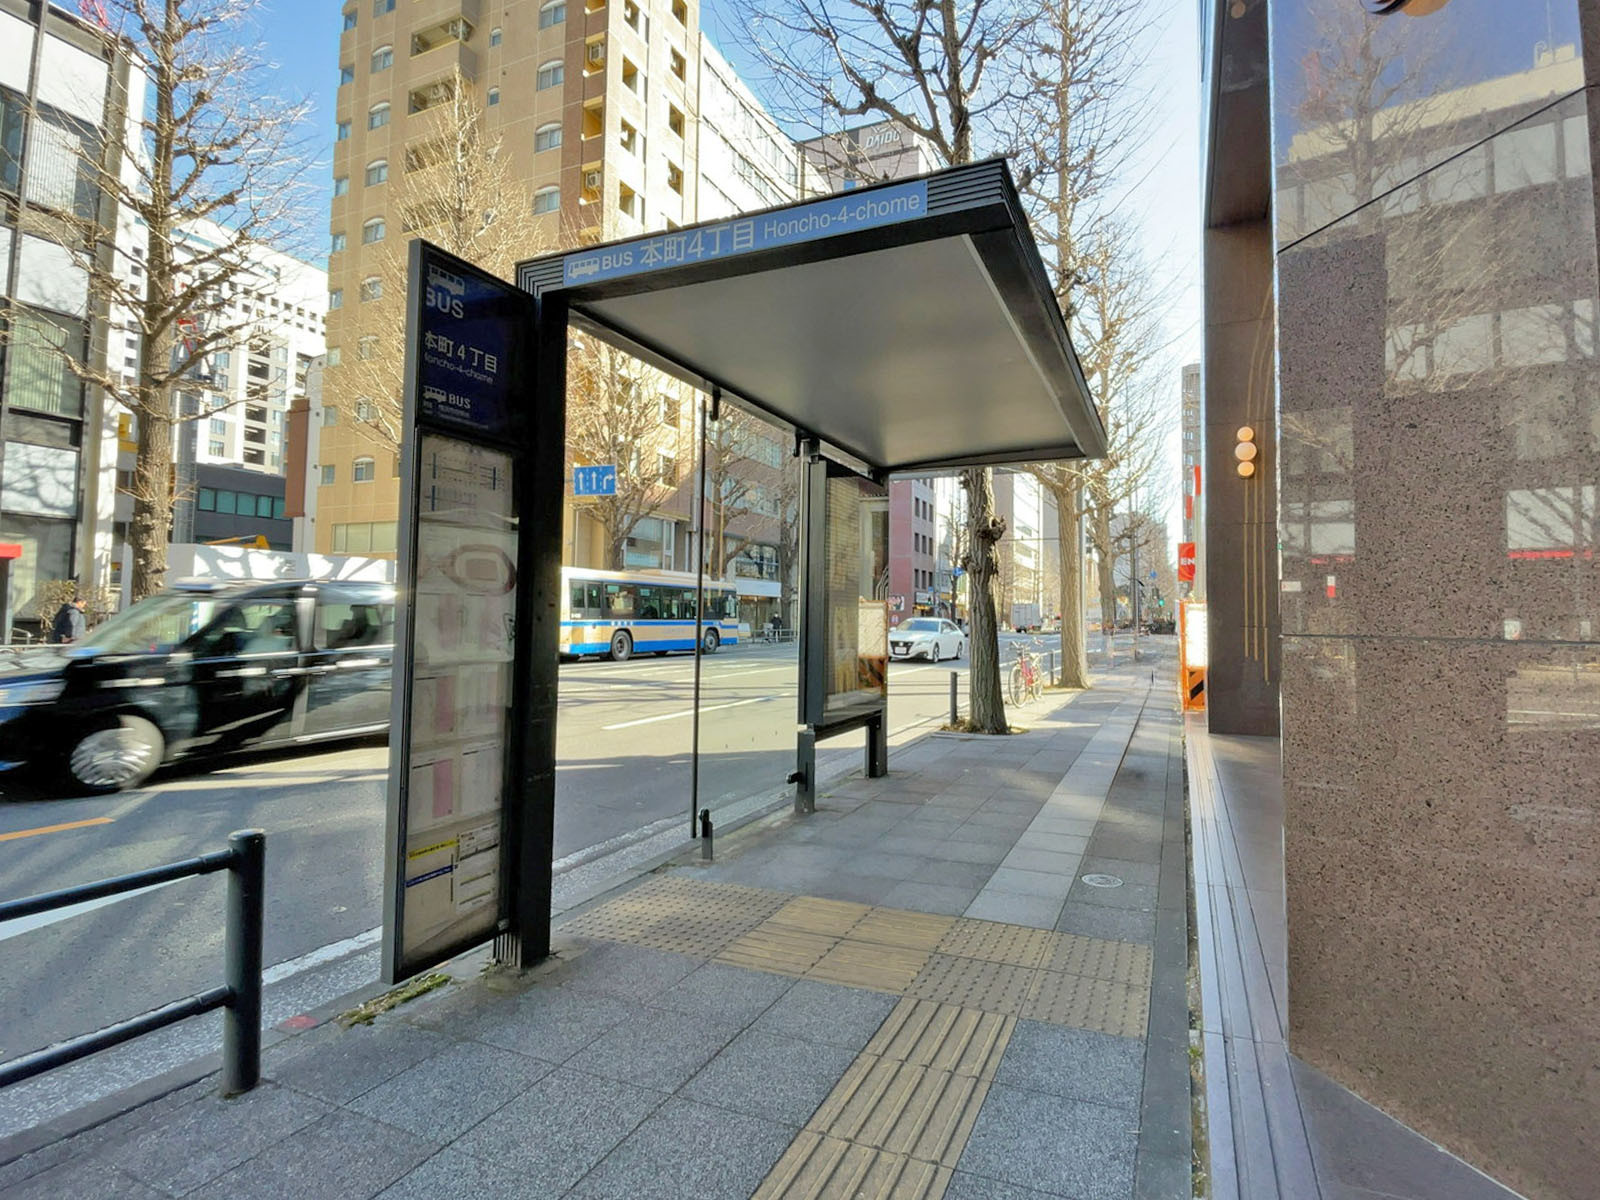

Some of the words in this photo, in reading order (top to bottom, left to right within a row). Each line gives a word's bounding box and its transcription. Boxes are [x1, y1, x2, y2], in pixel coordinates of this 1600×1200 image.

[602, 251, 633, 270] BUS
[640, 220, 754, 267] 本町4丁目
[764, 193, 920, 239] Honcho-4-chome
[426, 287, 464, 318] BUS
[448, 394, 471, 409] BUS
